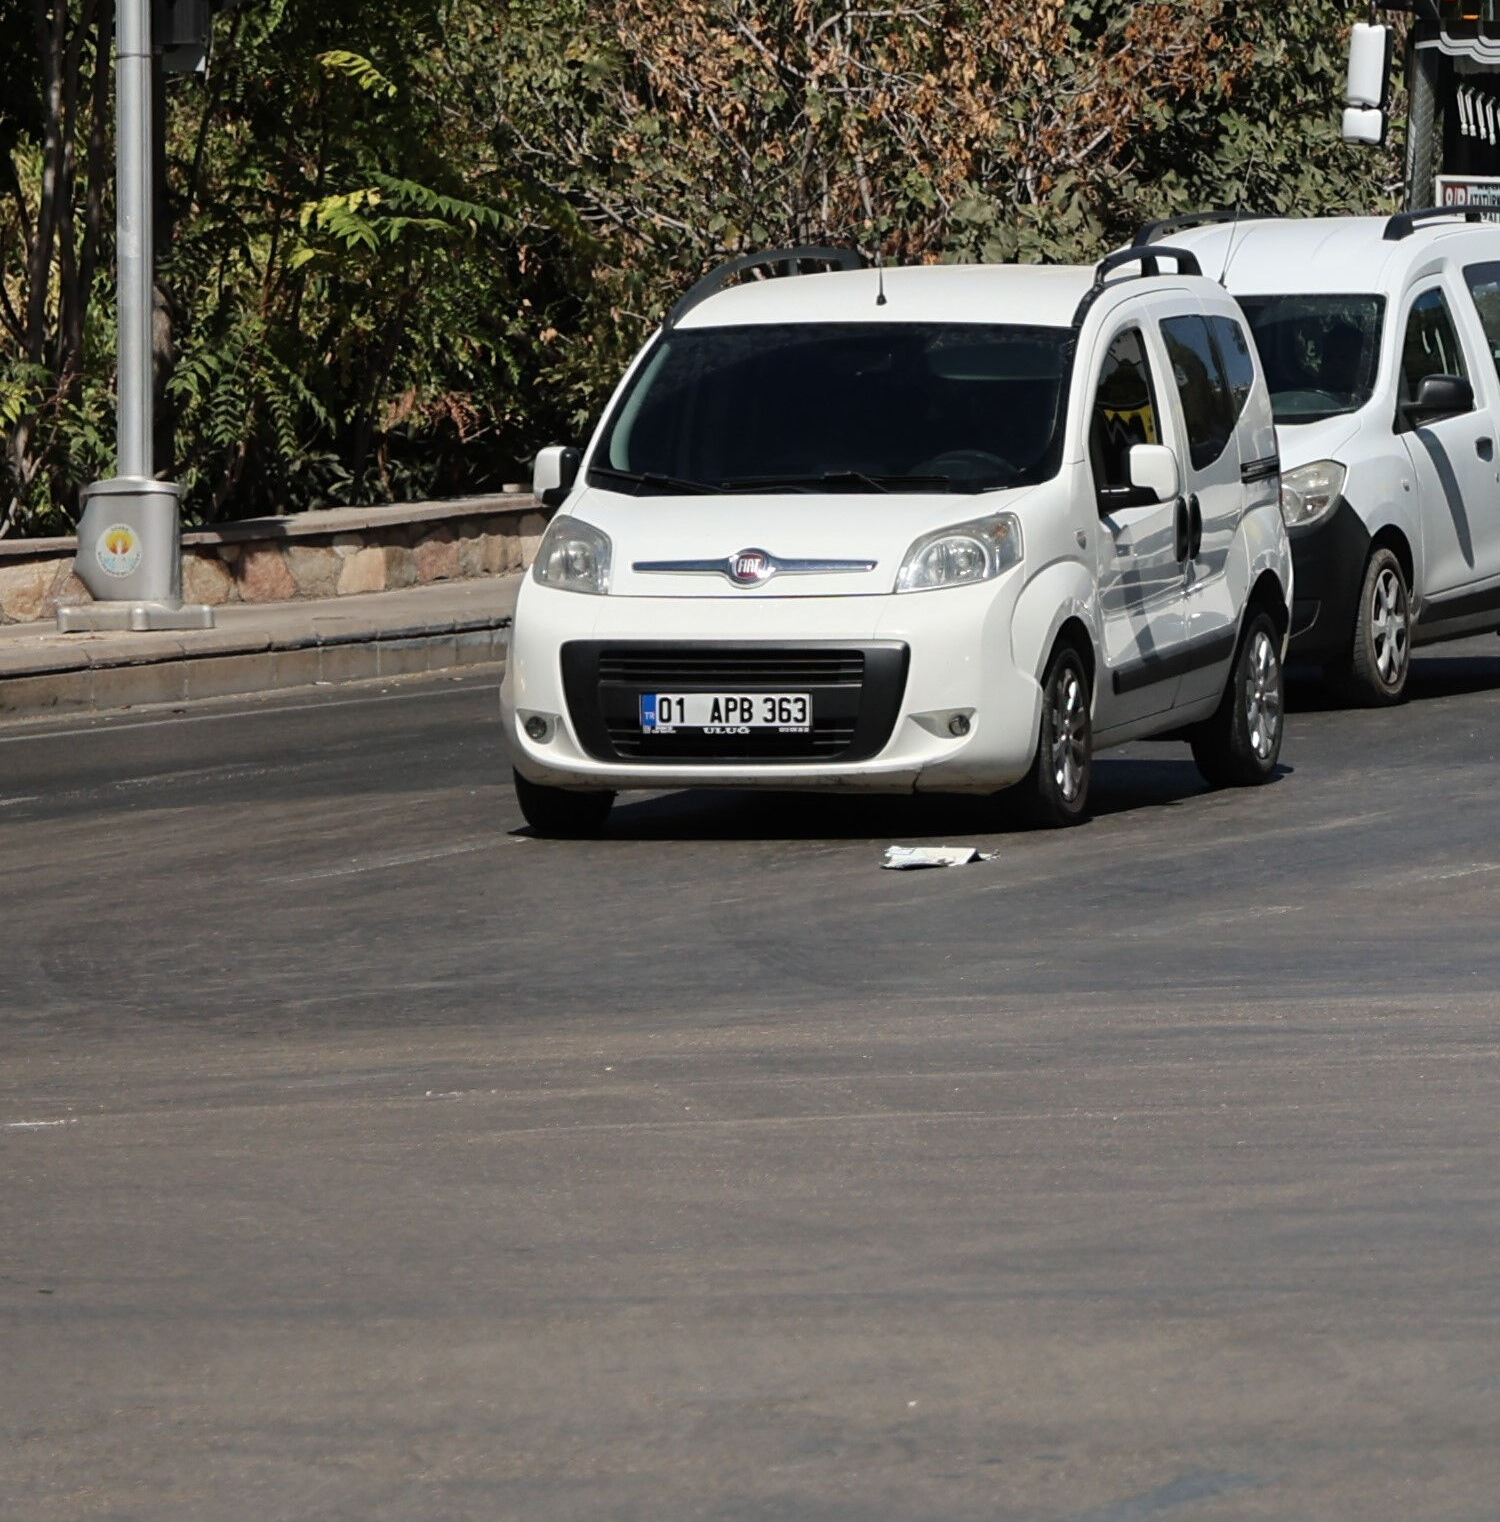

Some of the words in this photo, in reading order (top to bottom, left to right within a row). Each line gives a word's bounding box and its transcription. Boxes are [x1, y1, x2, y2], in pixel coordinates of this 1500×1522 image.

[738, 558, 761, 573] FIAT
[644, 711, 655, 720] TR
[658, 697, 685, 724] 01
[710, 697, 754, 724] APB
[763, 697, 807, 724] 363
